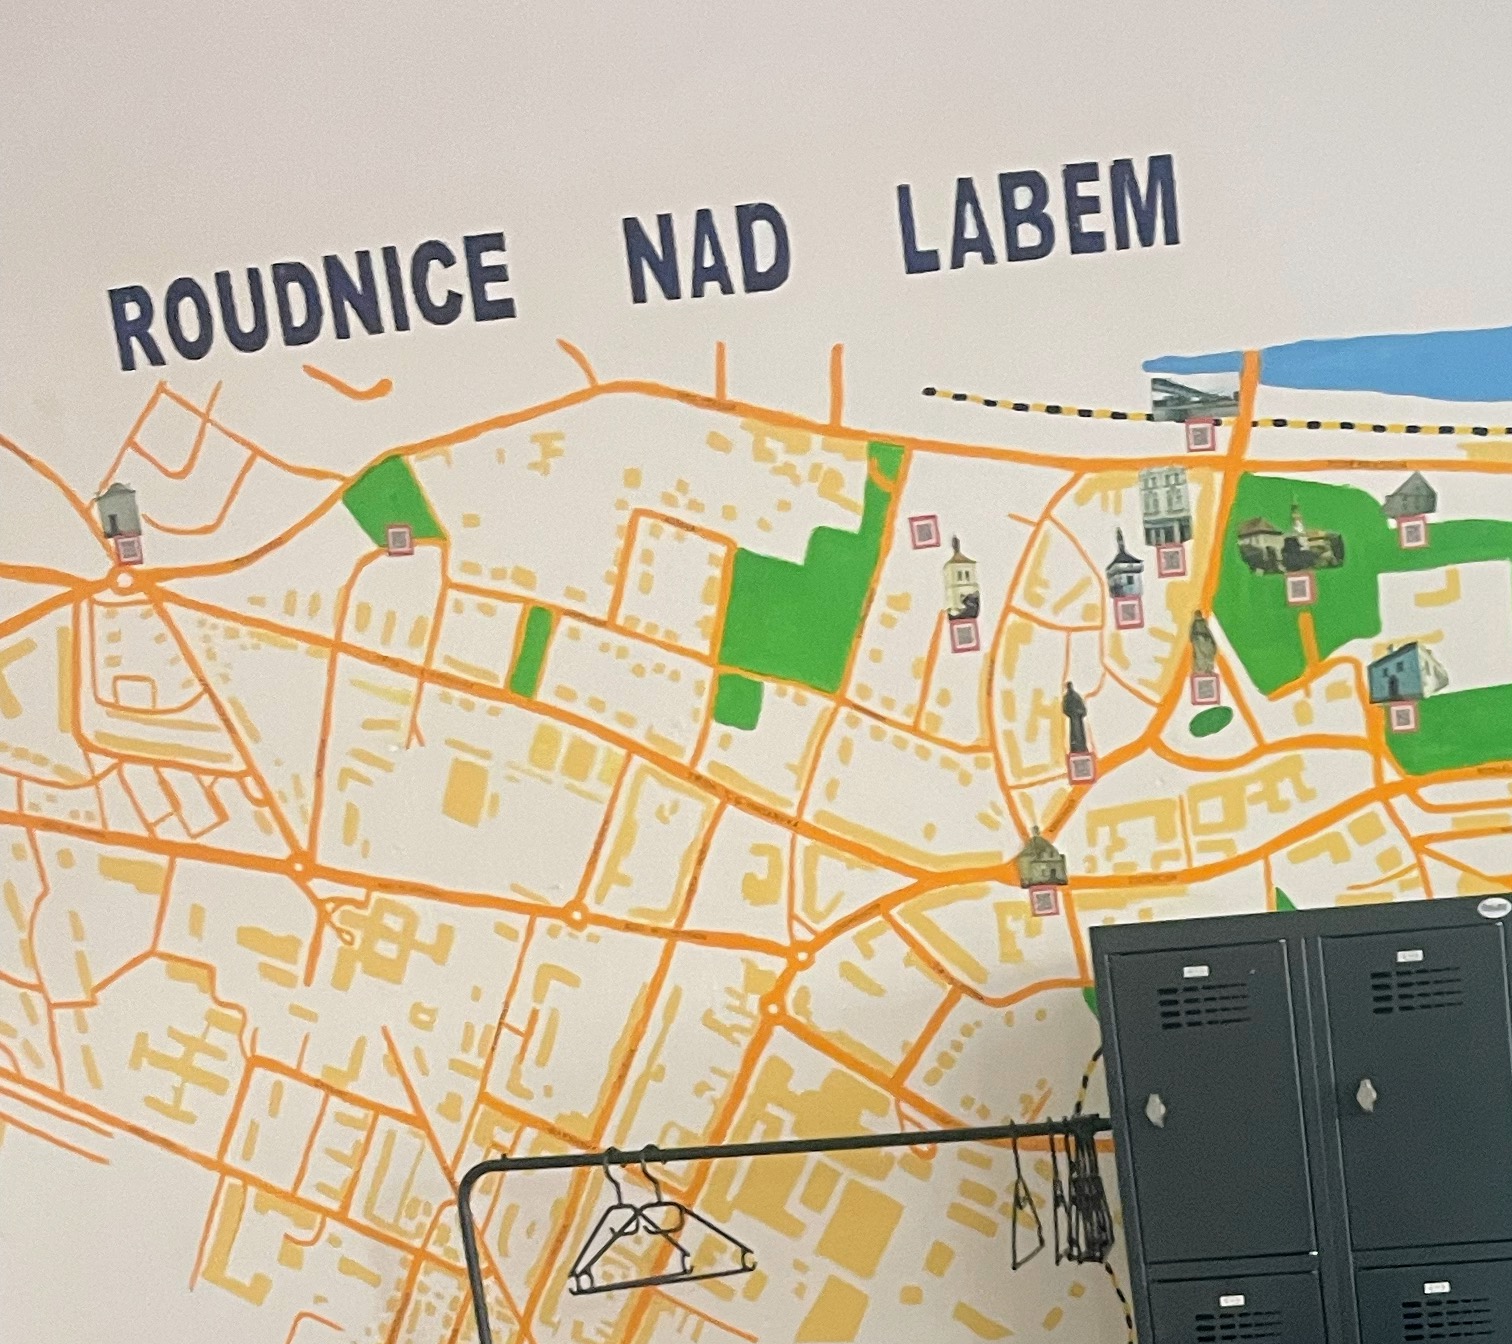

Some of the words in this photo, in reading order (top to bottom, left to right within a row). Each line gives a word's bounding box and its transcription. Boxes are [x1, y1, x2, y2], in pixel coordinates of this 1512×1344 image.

[107, 231, 517, 372] ROUDNICE
[622, 202, 791, 305] NAD
[896, 153, 1181, 275] LABEM
